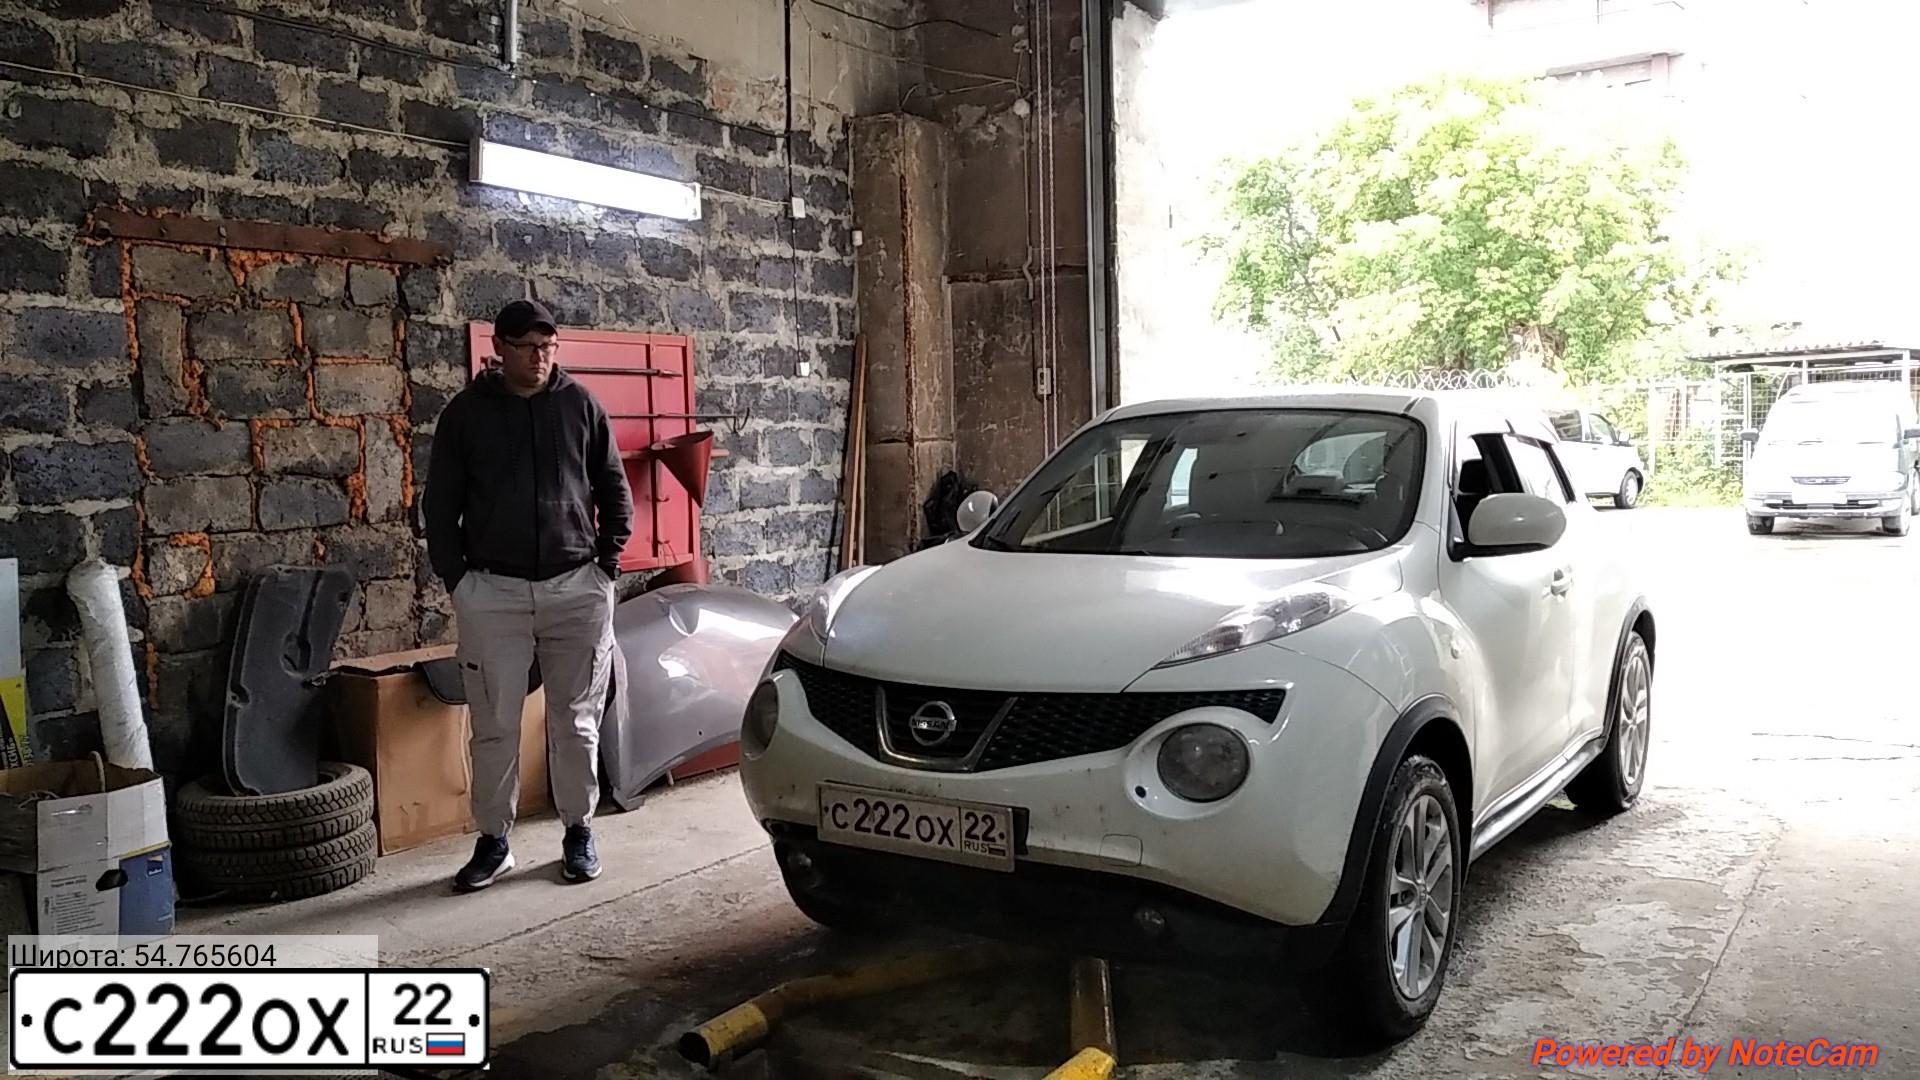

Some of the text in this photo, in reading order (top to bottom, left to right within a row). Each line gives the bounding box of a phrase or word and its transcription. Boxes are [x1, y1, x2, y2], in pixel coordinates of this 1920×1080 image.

[832, 798, 997, 848] C222OX 22
[964, 839, 990, 853] RUS
